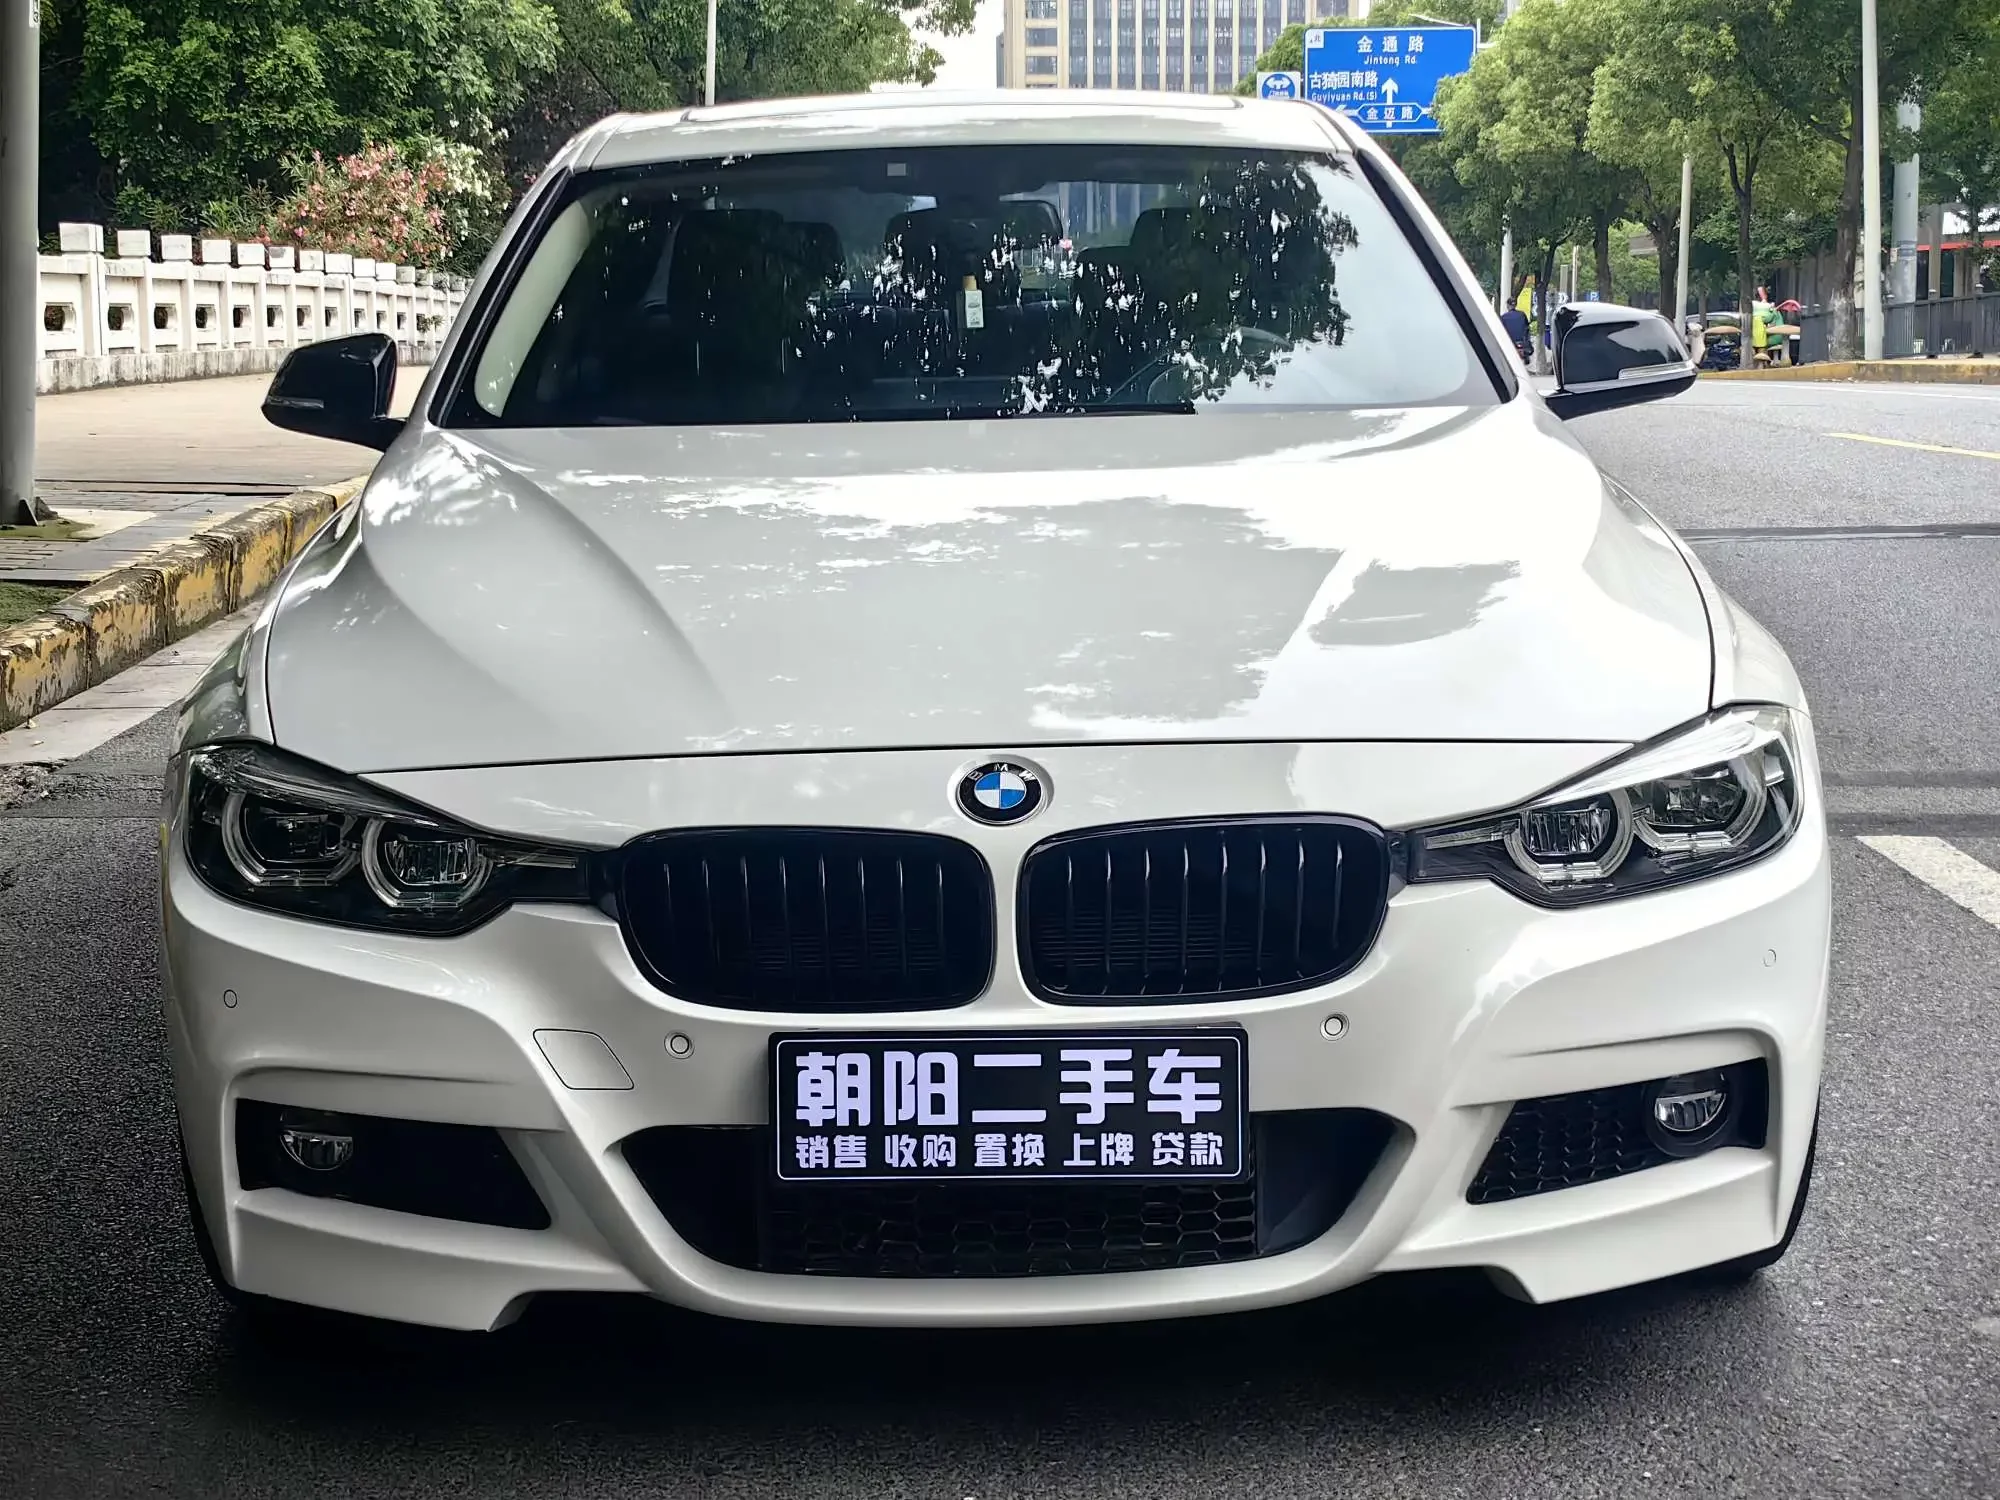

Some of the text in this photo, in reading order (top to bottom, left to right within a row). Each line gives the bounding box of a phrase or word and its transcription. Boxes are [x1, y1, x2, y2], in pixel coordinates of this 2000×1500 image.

[1357, 35, 1424, 53] 金通路
[1364, 55, 1400, 67] Jintong
[1309, 70, 1378, 90] 古猗园南路
[1311, 92, 1351, 104] Guyiyuan
[1366, 106, 1413, 120] 金迈路
[967, 763, 1037, 782] BMW
[795, 1048, 1223, 1127] 朝阳二手车
[795, 1131, 1223, 1169] 销售 收购 置换 上牌 贷款
